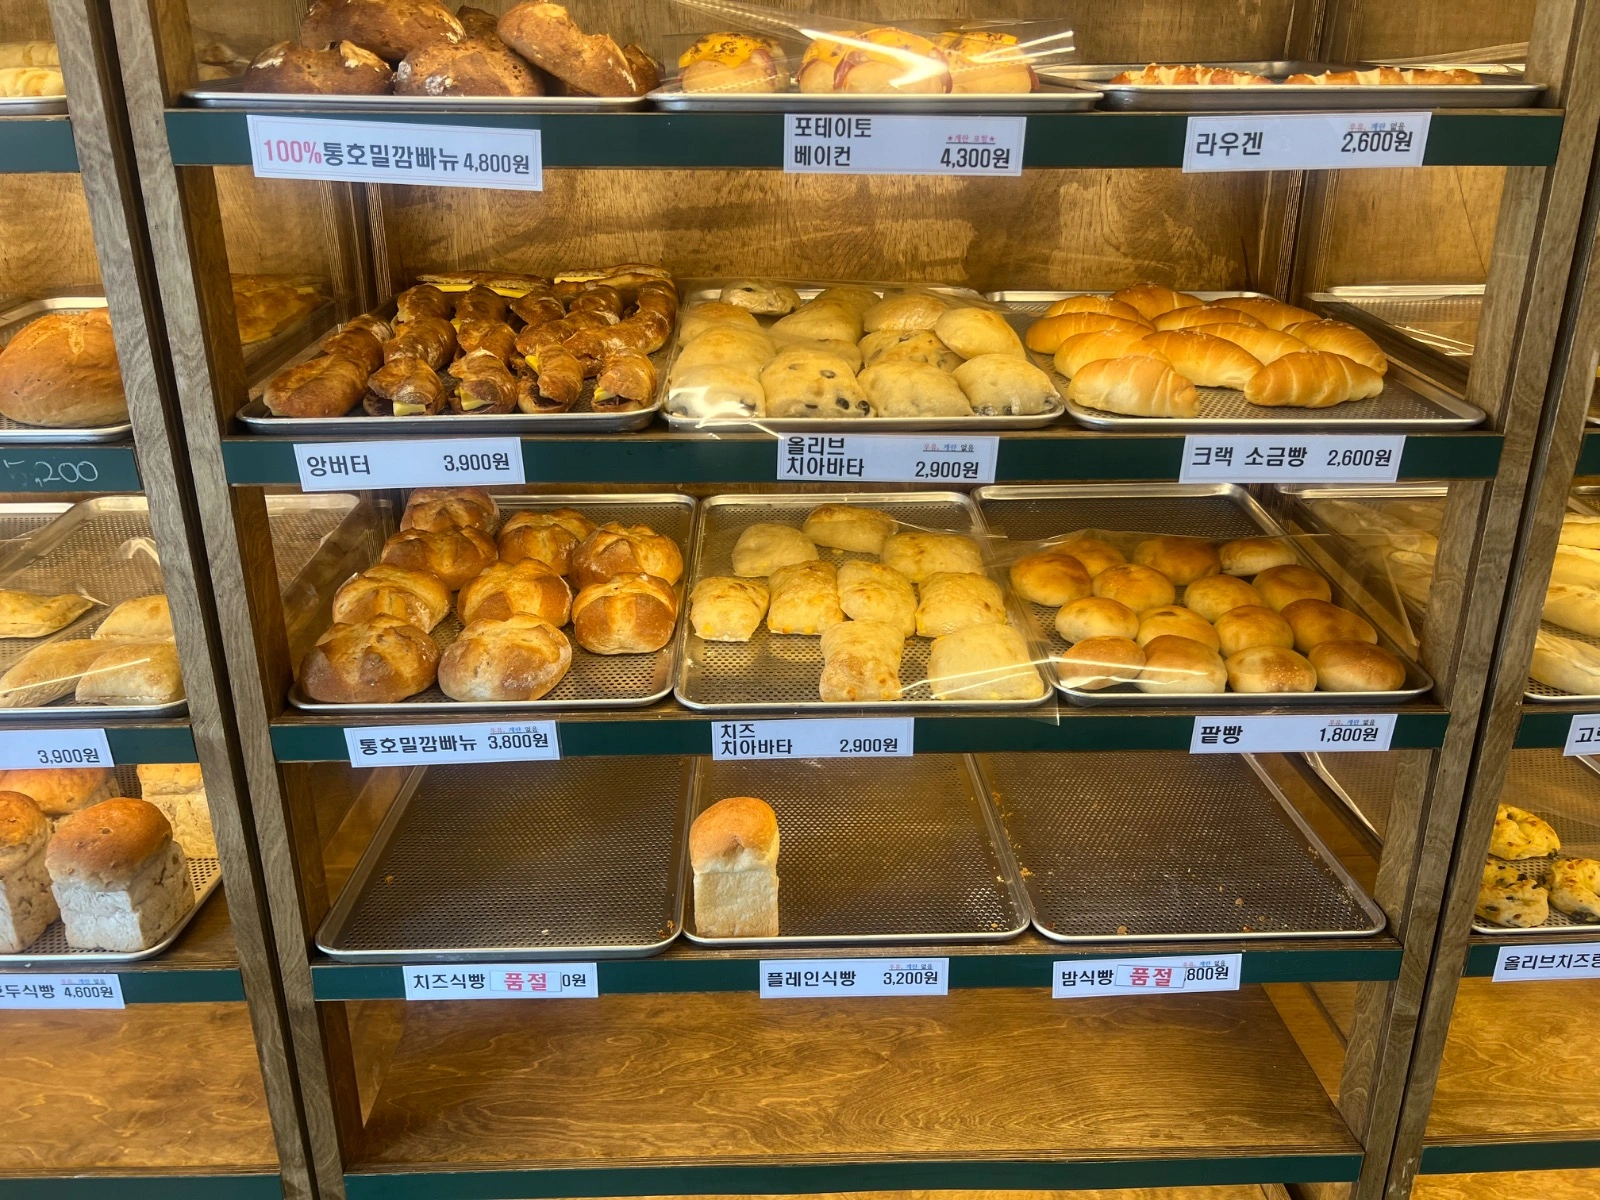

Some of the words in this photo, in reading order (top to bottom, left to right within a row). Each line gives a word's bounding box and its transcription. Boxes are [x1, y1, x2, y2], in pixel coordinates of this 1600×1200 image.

[794, 117, 872, 139] 포테이토
[1196, 132, 1263, 156] 라우겐
[1341, 132, 1412, 154] 2,600원
[463, 152, 530, 175] 4,800원
[794, 145, 851, 167] 베이컨
[940, 148, 1010, 169] 4,300원
[787, 437, 845, 456] 올리브
[306, 455, 371, 477] 앙버터
[444, 453, 510, 472] 3,900원
[1192, 446, 1234, 466] 크랙
[1244, 446, 1307, 467] 소금빵
[1327, 449, 1392, 467] 2,600원
[786, 457, 864, 477] 치아바타
[915, 461, 979, 479] 2,900원
[721, 724, 756, 739] 치즈
[1201, 725, 1243, 744] 팥빵
[1319, 727, 1379, 742] 1,800원
[359, 735, 477, 755] 통호밀깜빠뉴
[488, 733, 548, 750] 3,800원
[721, 739, 792, 755] 치아바타
[840, 738, 898, 753] 2,900원
[38, 748, 100, 764] 3,900원
[414, 974, 485, 990] 치즈식빵
[504, 973, 547, 991] 품절
[767, 971, 856, 987] 플레인식빵
[883, 971, 938, 985] 3,200원
[1062, 969, 1114, 987] 밤식빵
[1130, 967, 1172, 987] 품절
[64, 987, 114, 998] 4,600원
